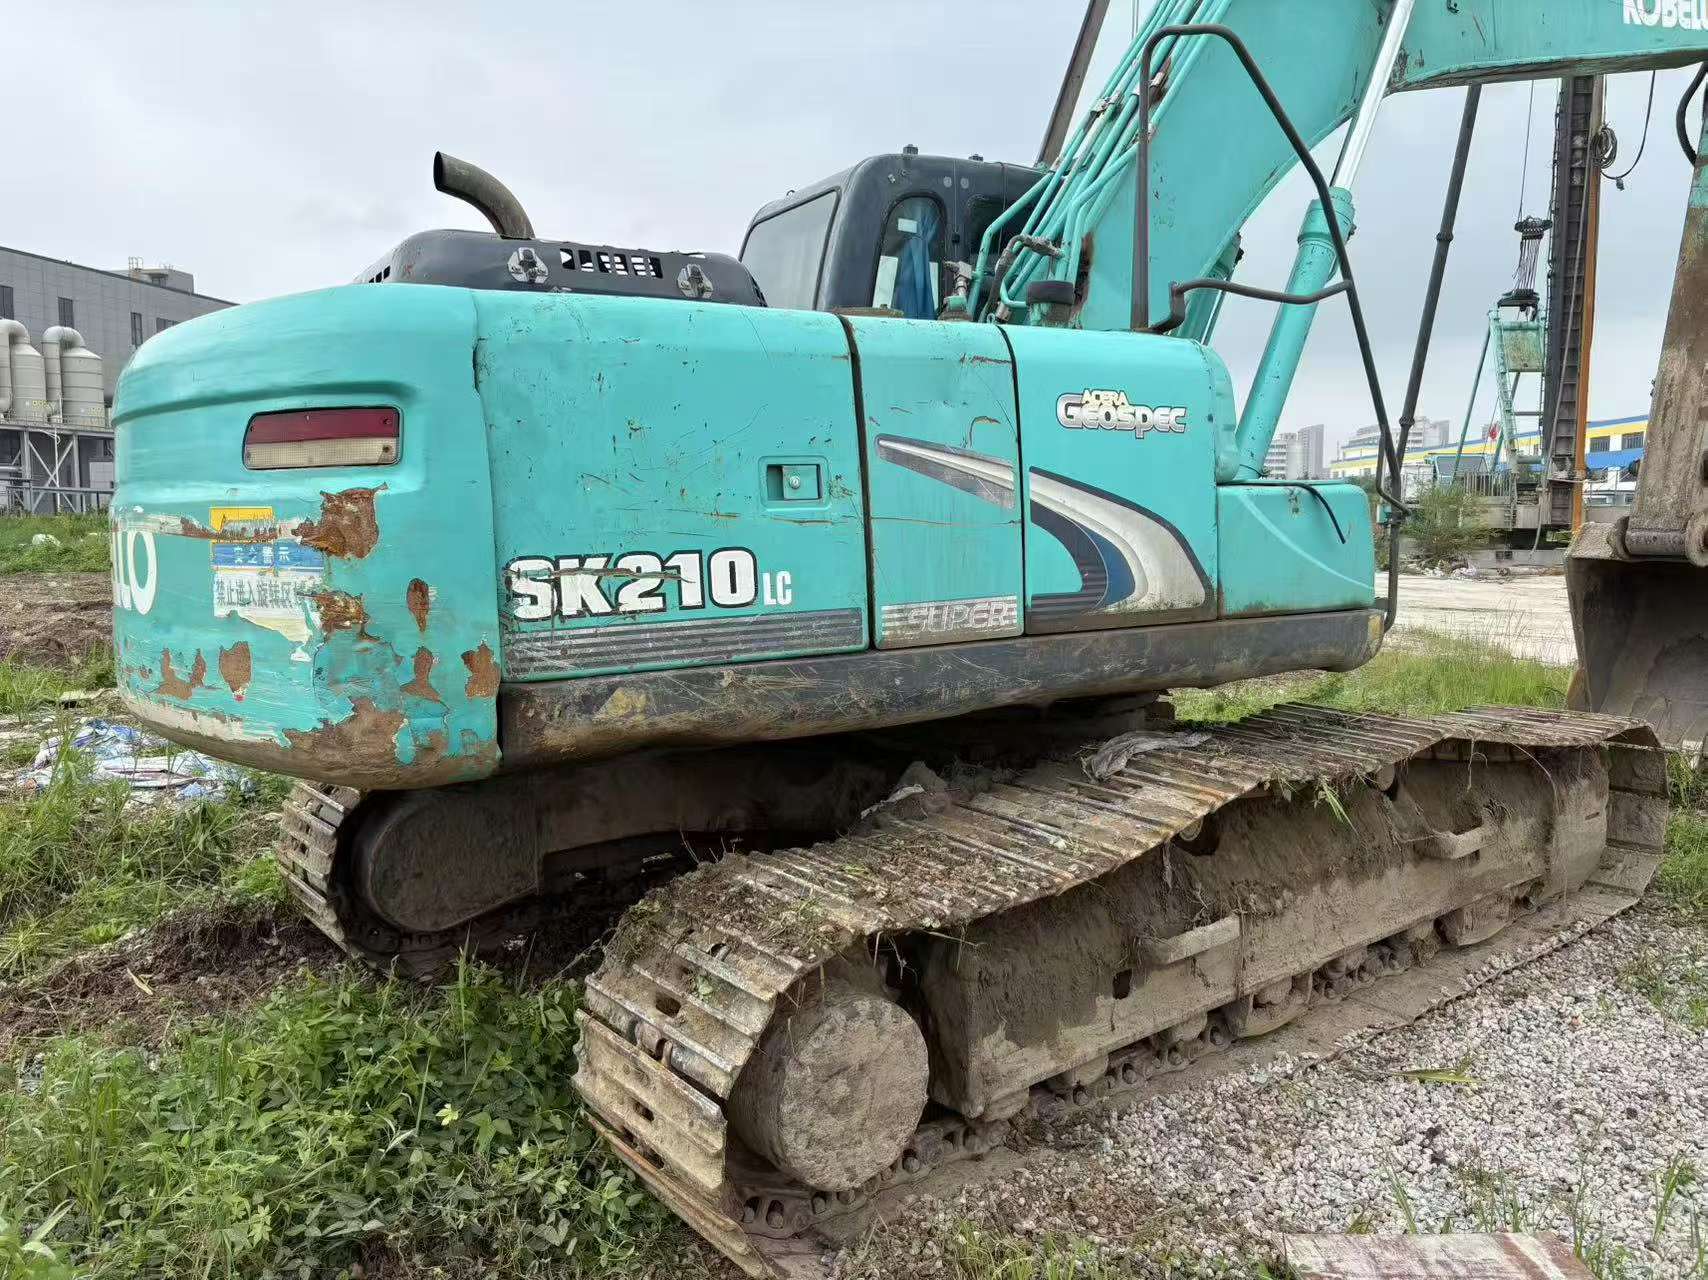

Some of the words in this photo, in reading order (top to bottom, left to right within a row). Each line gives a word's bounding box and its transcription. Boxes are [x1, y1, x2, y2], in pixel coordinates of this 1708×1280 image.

[505, 546, 757, 622] SK210
[763, 570, 792, 606] LC
[908, 600, 1012, 632] SUPER
